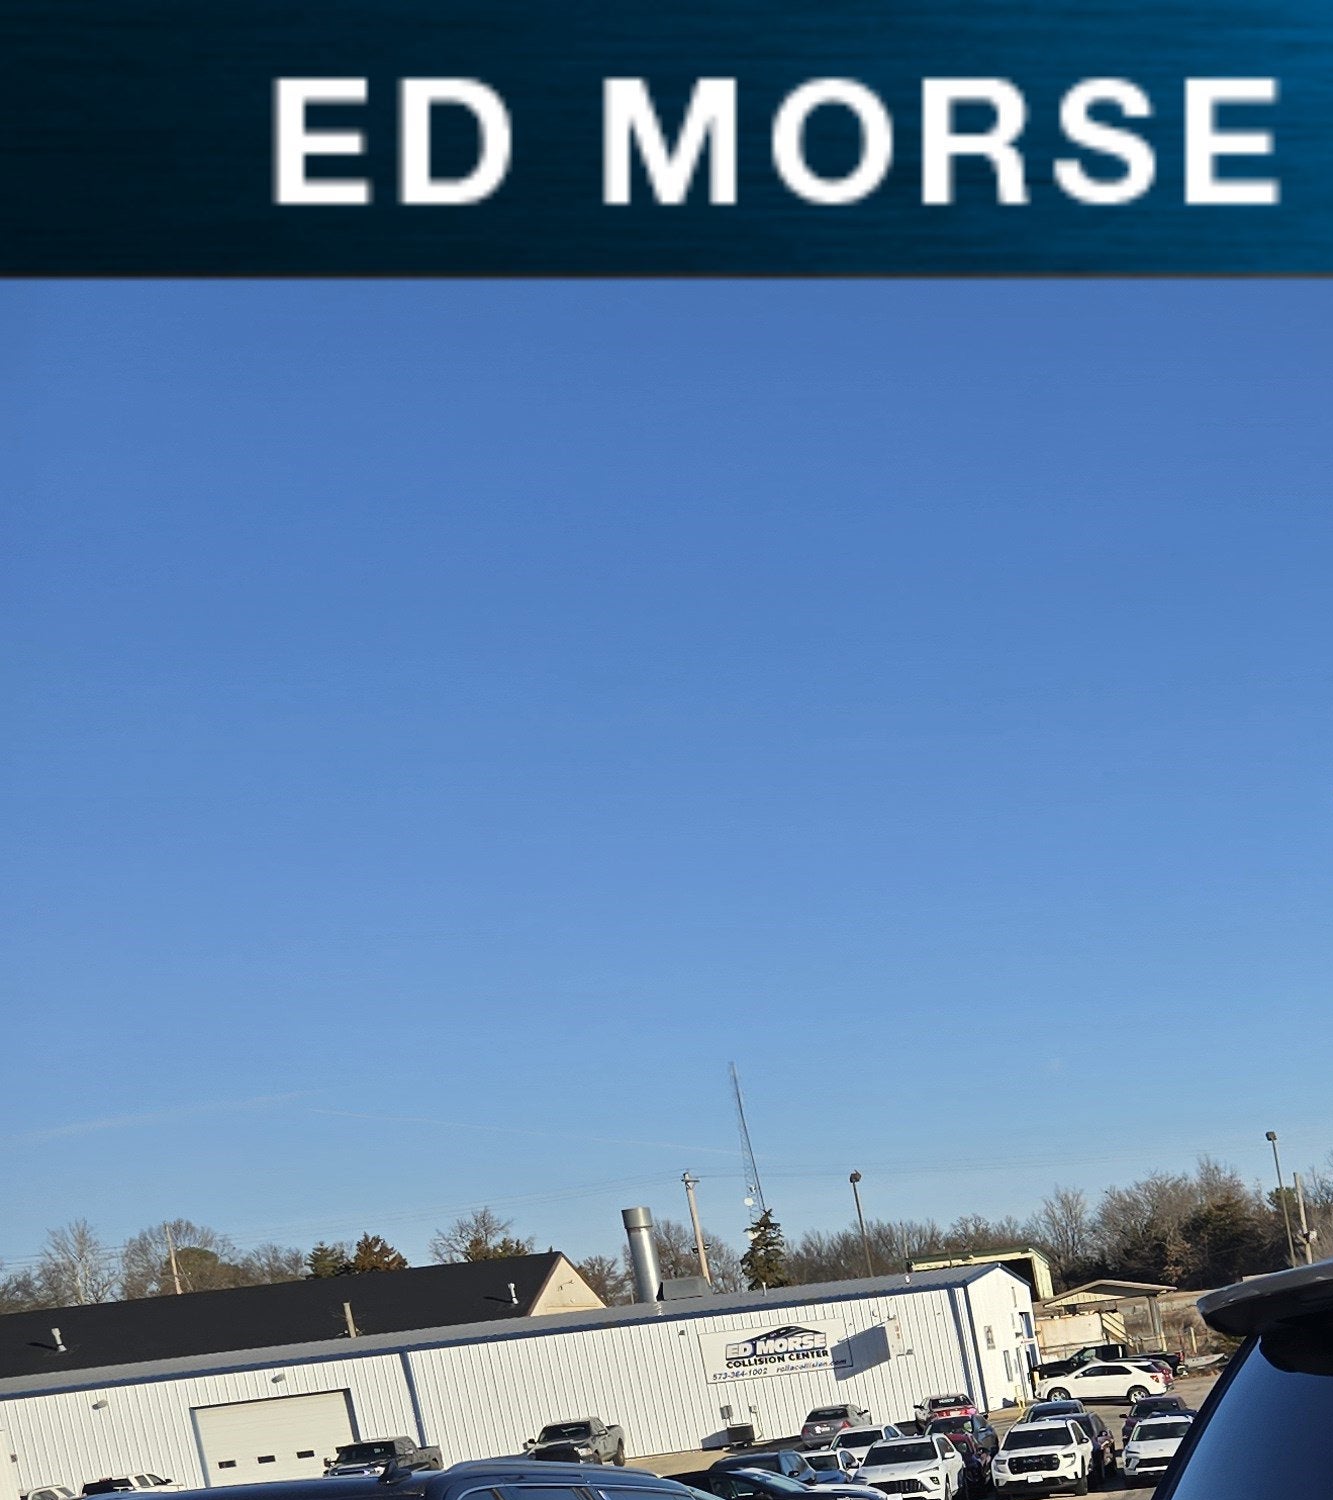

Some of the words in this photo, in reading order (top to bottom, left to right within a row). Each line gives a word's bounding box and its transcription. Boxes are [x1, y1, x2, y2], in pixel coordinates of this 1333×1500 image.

[725, 1341, 753, 1361] ED
[755, 1332, 827, 1357] MORSE
[726, 1353, 790, 1370] COLLISION
[789, 1349, 830, 1362] CENTER
